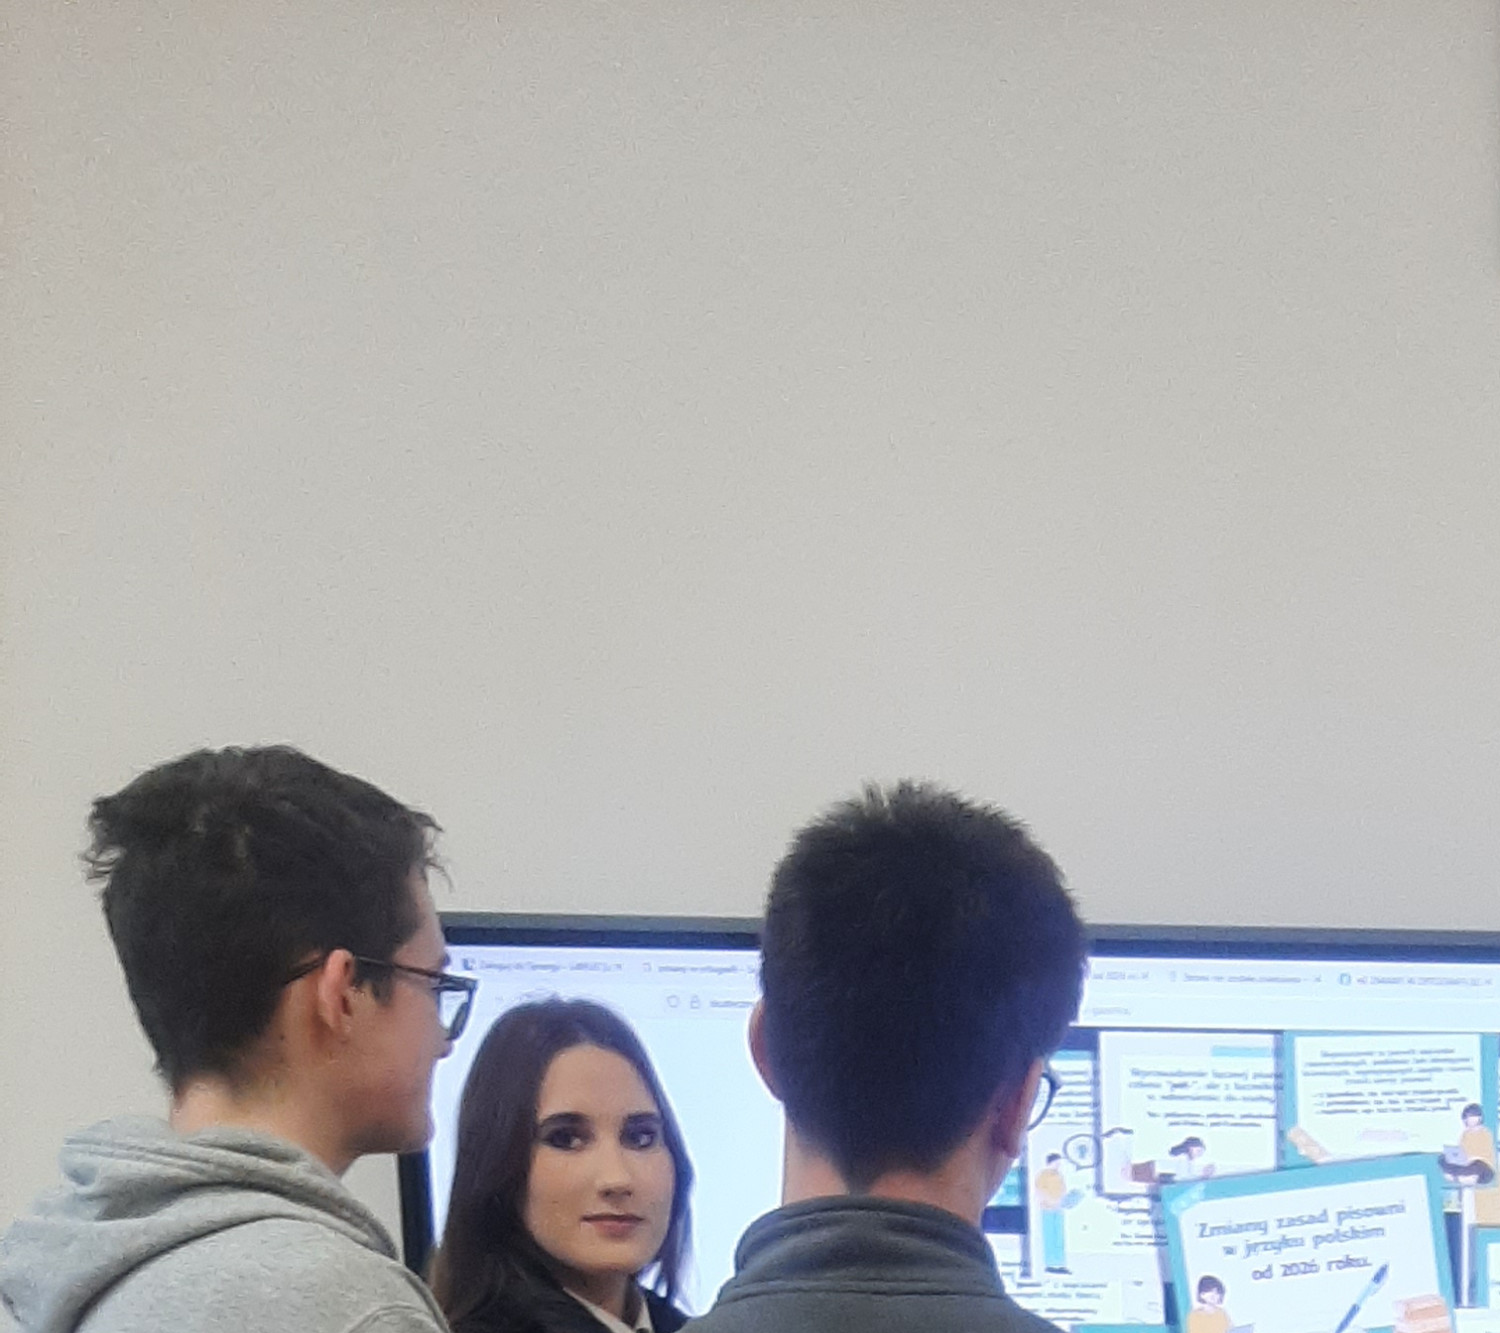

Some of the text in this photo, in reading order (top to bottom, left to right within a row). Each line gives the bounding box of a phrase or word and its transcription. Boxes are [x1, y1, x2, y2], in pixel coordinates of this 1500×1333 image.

[1196, 1200, 1406, 1239] Zmiany zasad pisowni
[1312, 1225, 1386, 1249] polskim
[1251, 1264, 1274, 1281] od
[1280, 1259, 1321, 1278] 2026
